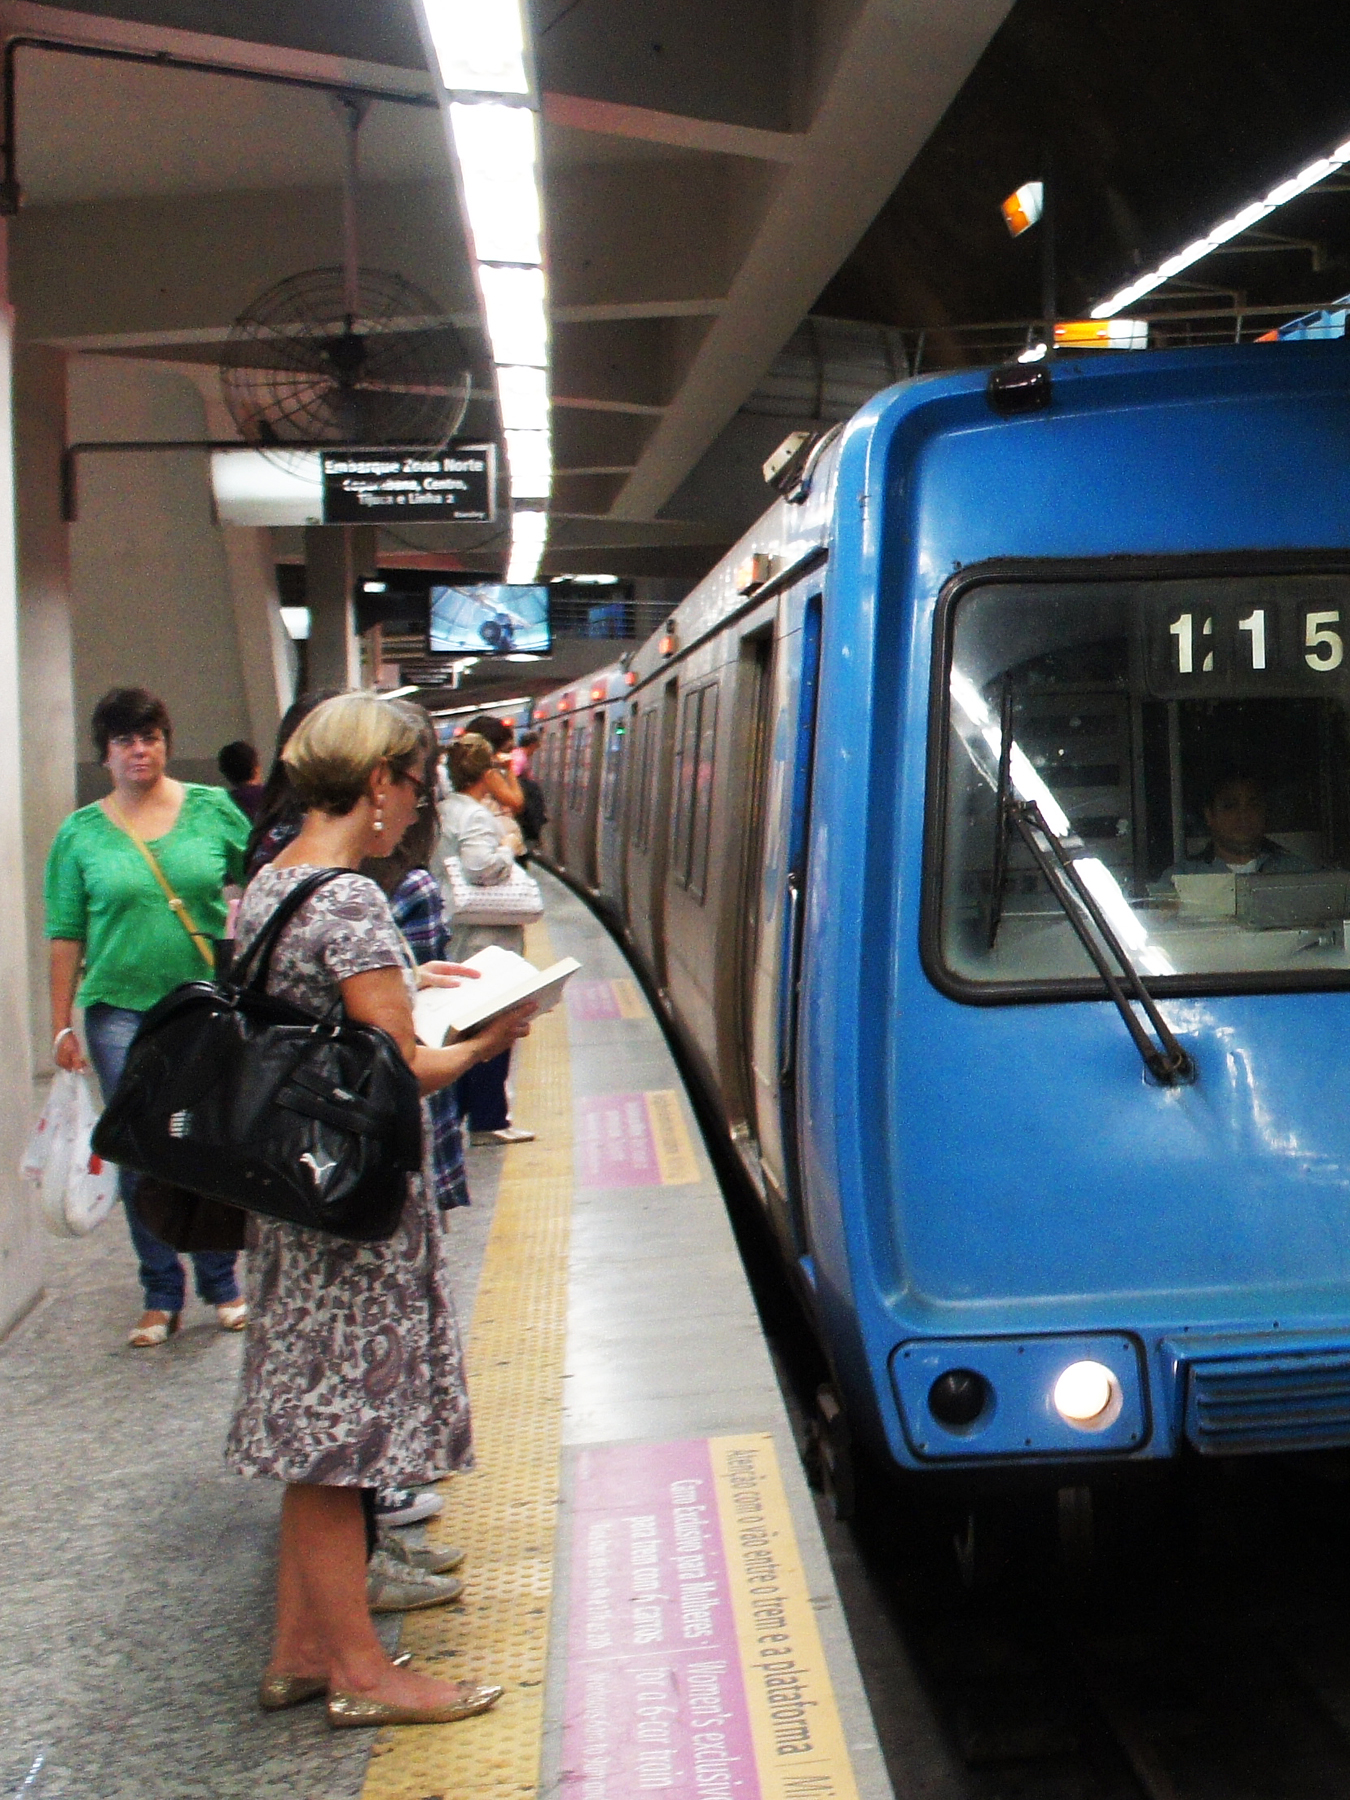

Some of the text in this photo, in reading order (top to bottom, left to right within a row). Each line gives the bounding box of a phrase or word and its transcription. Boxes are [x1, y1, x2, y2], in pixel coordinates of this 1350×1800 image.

[324, 458, 485, 476] Embarque Zona Norte
[721, 1448, 768, 1490] Atenção
[733, 1491, 763, 1513] com
[737, 1515, 766, 1524] o
[739, 1524, 780, 1548] vão
[668, 1478, 720, 1639] Carro Exclusivo para Mulheres
[743, 1549, 781, 1583] entre
[621, 1515, 669, 1645] para trem com 6 carros
[749, 1585, 780, 1595] o
[751, 1596, 789, 1631] trem
[757, 1632, 791, 1644] e
[759, 1646, 794, 1658] a
[685, 1660, 733, 1728] Women's
[752, 1659, 820, 1756] plataforma
[623, 1665, 684, 1789] for a 6-car train
